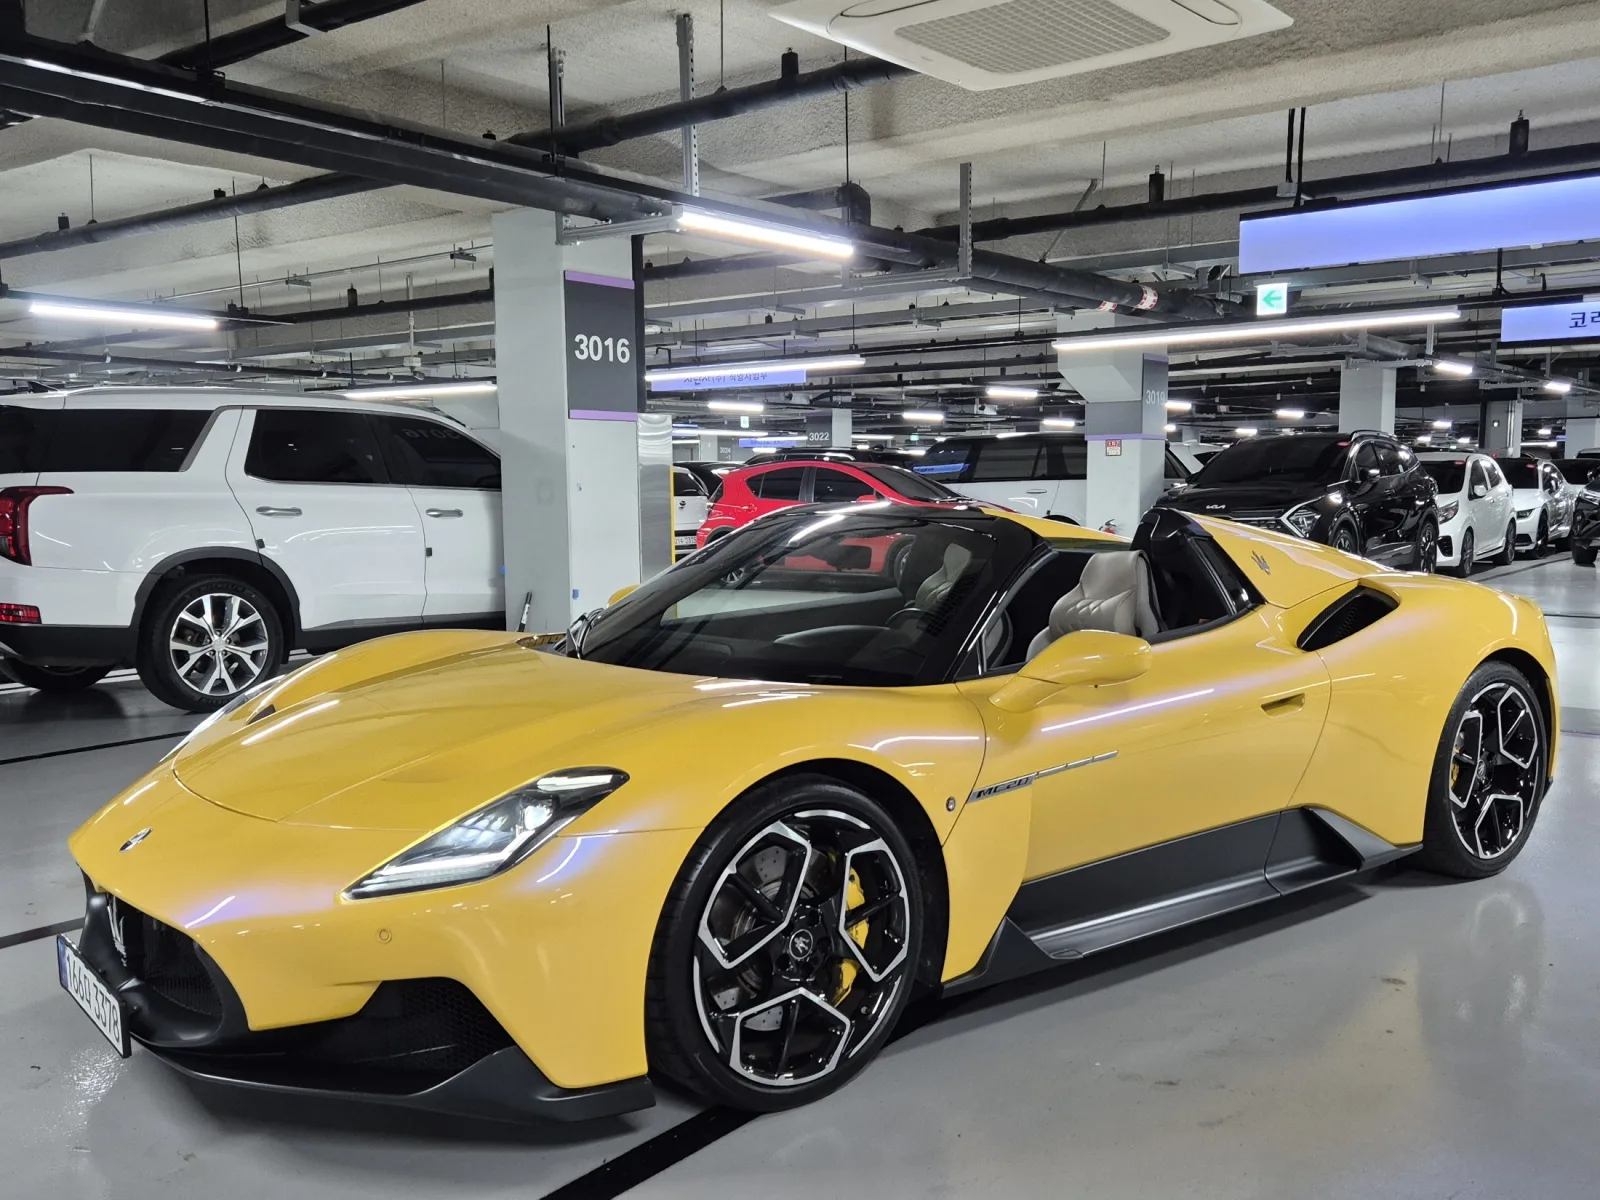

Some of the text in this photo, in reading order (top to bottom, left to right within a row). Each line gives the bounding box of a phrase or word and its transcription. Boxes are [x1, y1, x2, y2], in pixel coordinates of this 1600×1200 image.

[574, 333, 630, 364] 3016
[1145, 389, 1166, 405] 3019
[809, 432, 830, 441] 3022
[976, 777, 1029, 799] MC20
[93, 982, 120, 1044] 3378
